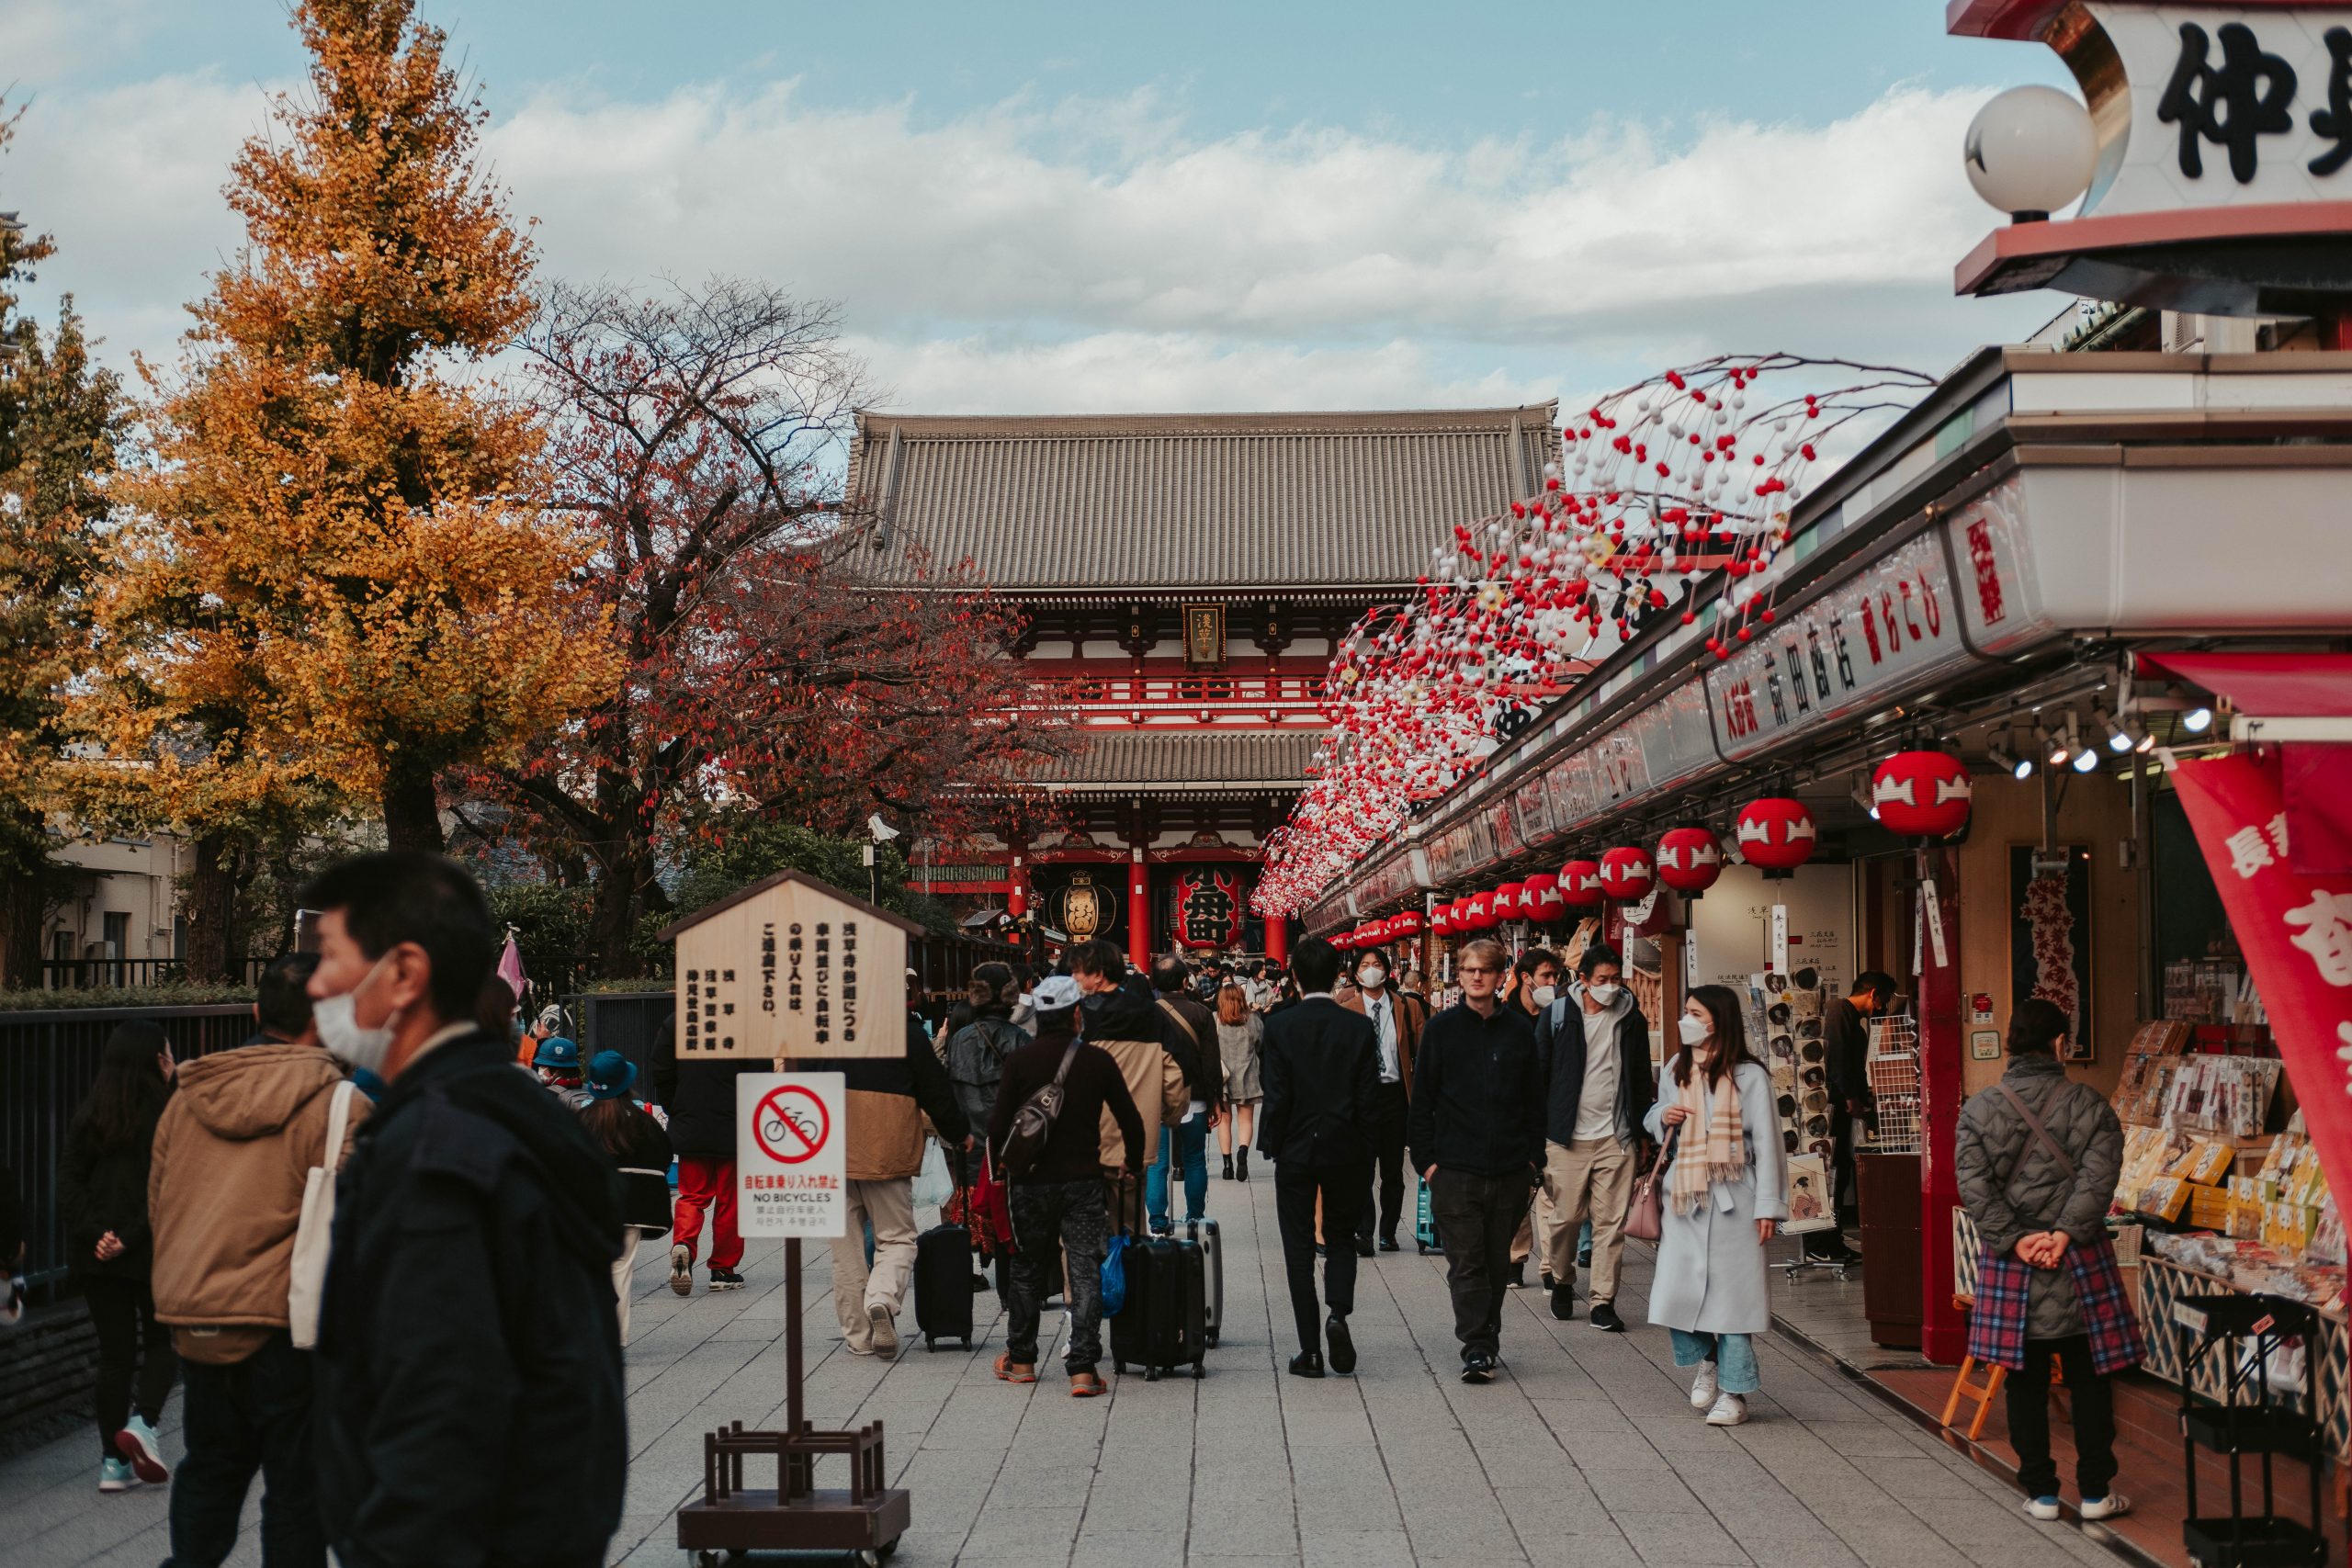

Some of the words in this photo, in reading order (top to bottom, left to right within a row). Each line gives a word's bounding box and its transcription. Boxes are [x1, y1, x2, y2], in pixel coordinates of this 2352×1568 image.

[1183, 867, 1235, 945] 小舟町
[685, 969, 699, 1051] 仲見世商店街
[787, 922, 804, 1016] の乗り入れは、
[815, 921, 830, 1045] 車両並びに自転車
[842, 921, 857, 1043] 浅草寺参道につき
[744, 1175, 839, 1190] 自転車乗り入れ禁止
[753, 1193, 771, 1202] NO
[774, 1193, 831, 1202] BICYCLES
